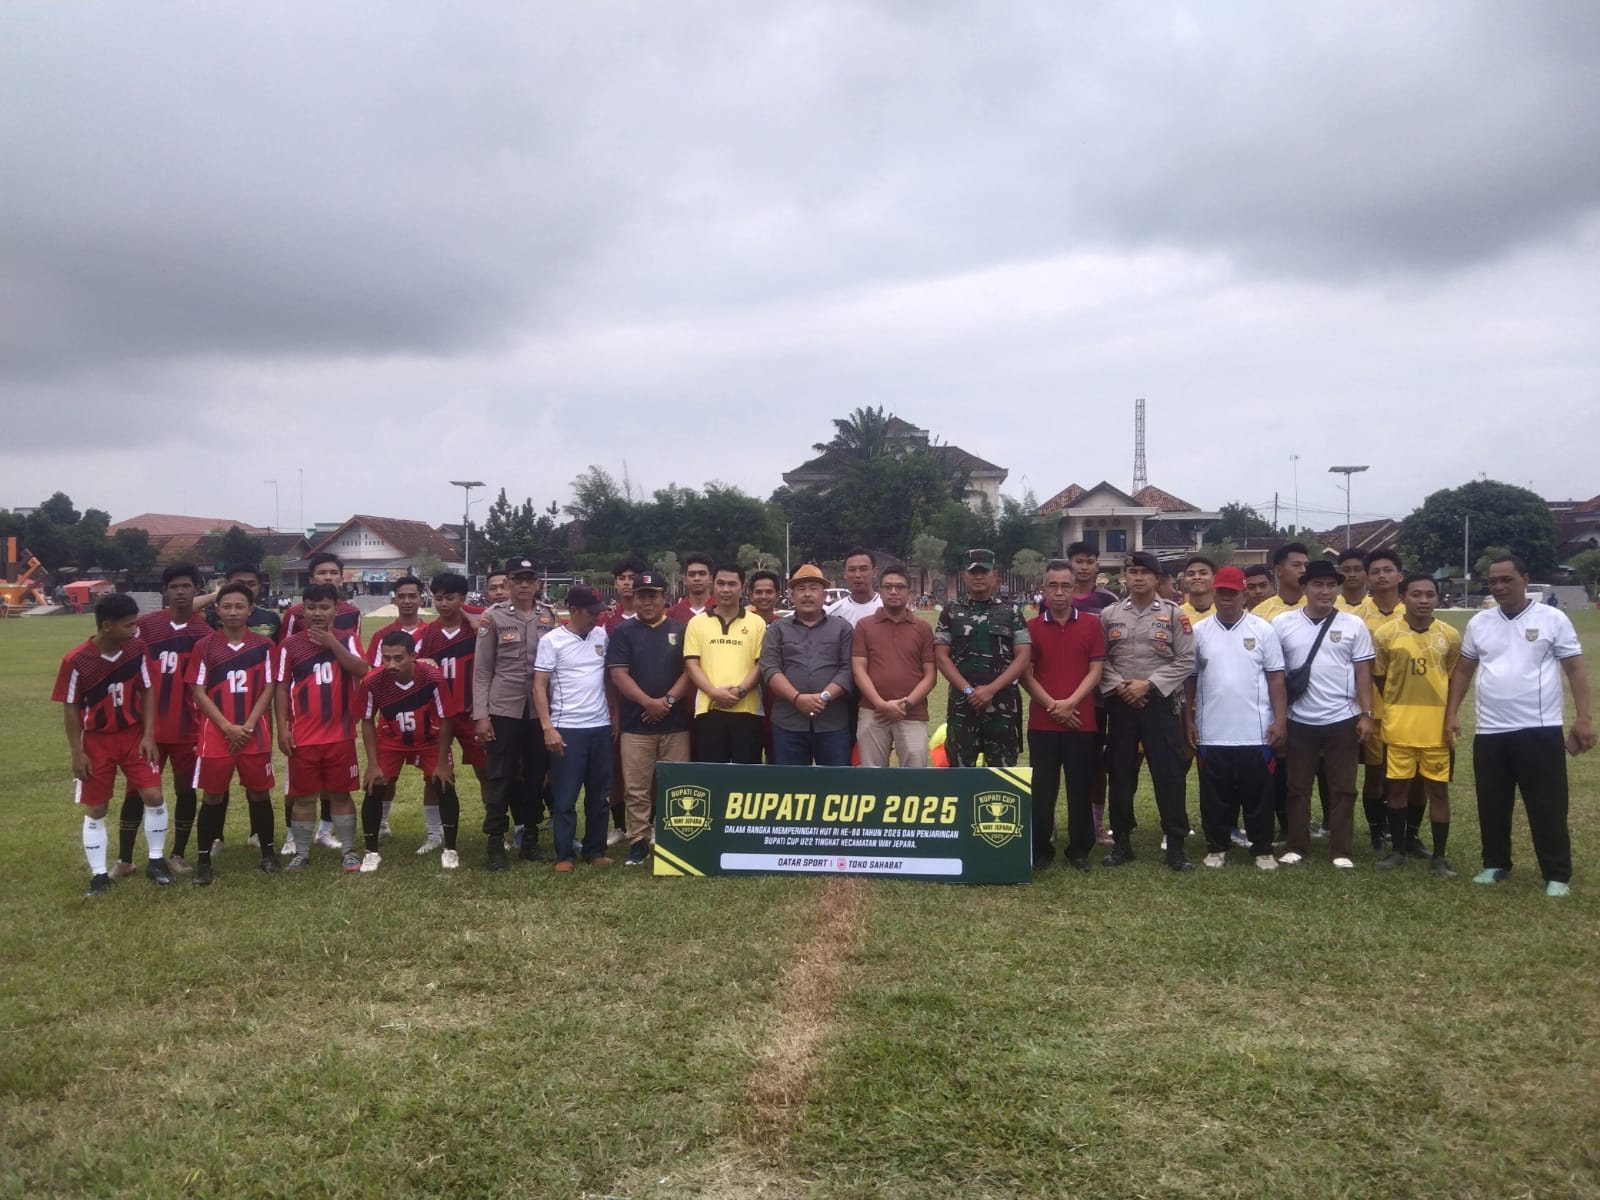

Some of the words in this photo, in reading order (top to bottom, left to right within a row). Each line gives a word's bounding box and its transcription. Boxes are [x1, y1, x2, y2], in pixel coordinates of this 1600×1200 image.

[709, 638, 744, 646] MIRAGE
[159, 650, 178, 674] 19
[440, 656, 457, 679] 11
[1409, 657, 1428, 676] 13
[226, 669, 249, 693] 12
[313, 661, 333, 685] 10
[107, 682, 125, 707] 13
[396, 711, 417, 733] 15
[693, 790, 706, 799] CUP
[1002, 795, 1016, 804] CUP
[725, 792, 817, 820] BUPATI
[822, 794, 876, 822] CUP
[882, 796, 958, 824] 2025
[724, 825, 746, 834] DALAM
[746, 825, 771, 834] RANGKA
[771, 826, 819, 835] MEMPERINGATI
[819, 827, 832, 836] HUT
[832, 828, 840, 836] RI
[862, 829, 882, 837] TAHUN
[902, 829, 916, 838] DAN
[916, 830, 959, 839] PENJARINGAN
[764, 836, 786, 846] BUPATI
[786, 837, 800, 846] CUP
[800, 837, 813, 846] U22
[814, 838, 840, 847] TINGKAT
[841, 838, 877, 847] KECAMATAN
[878, 839, 892, 848] WAY
[778, 858, 801, 867] QATAR
[803, 859, 828, 868] SPORT
[849, 860, 867, 869] TOKO
[869, 861, 903, 870] SAHABAT
